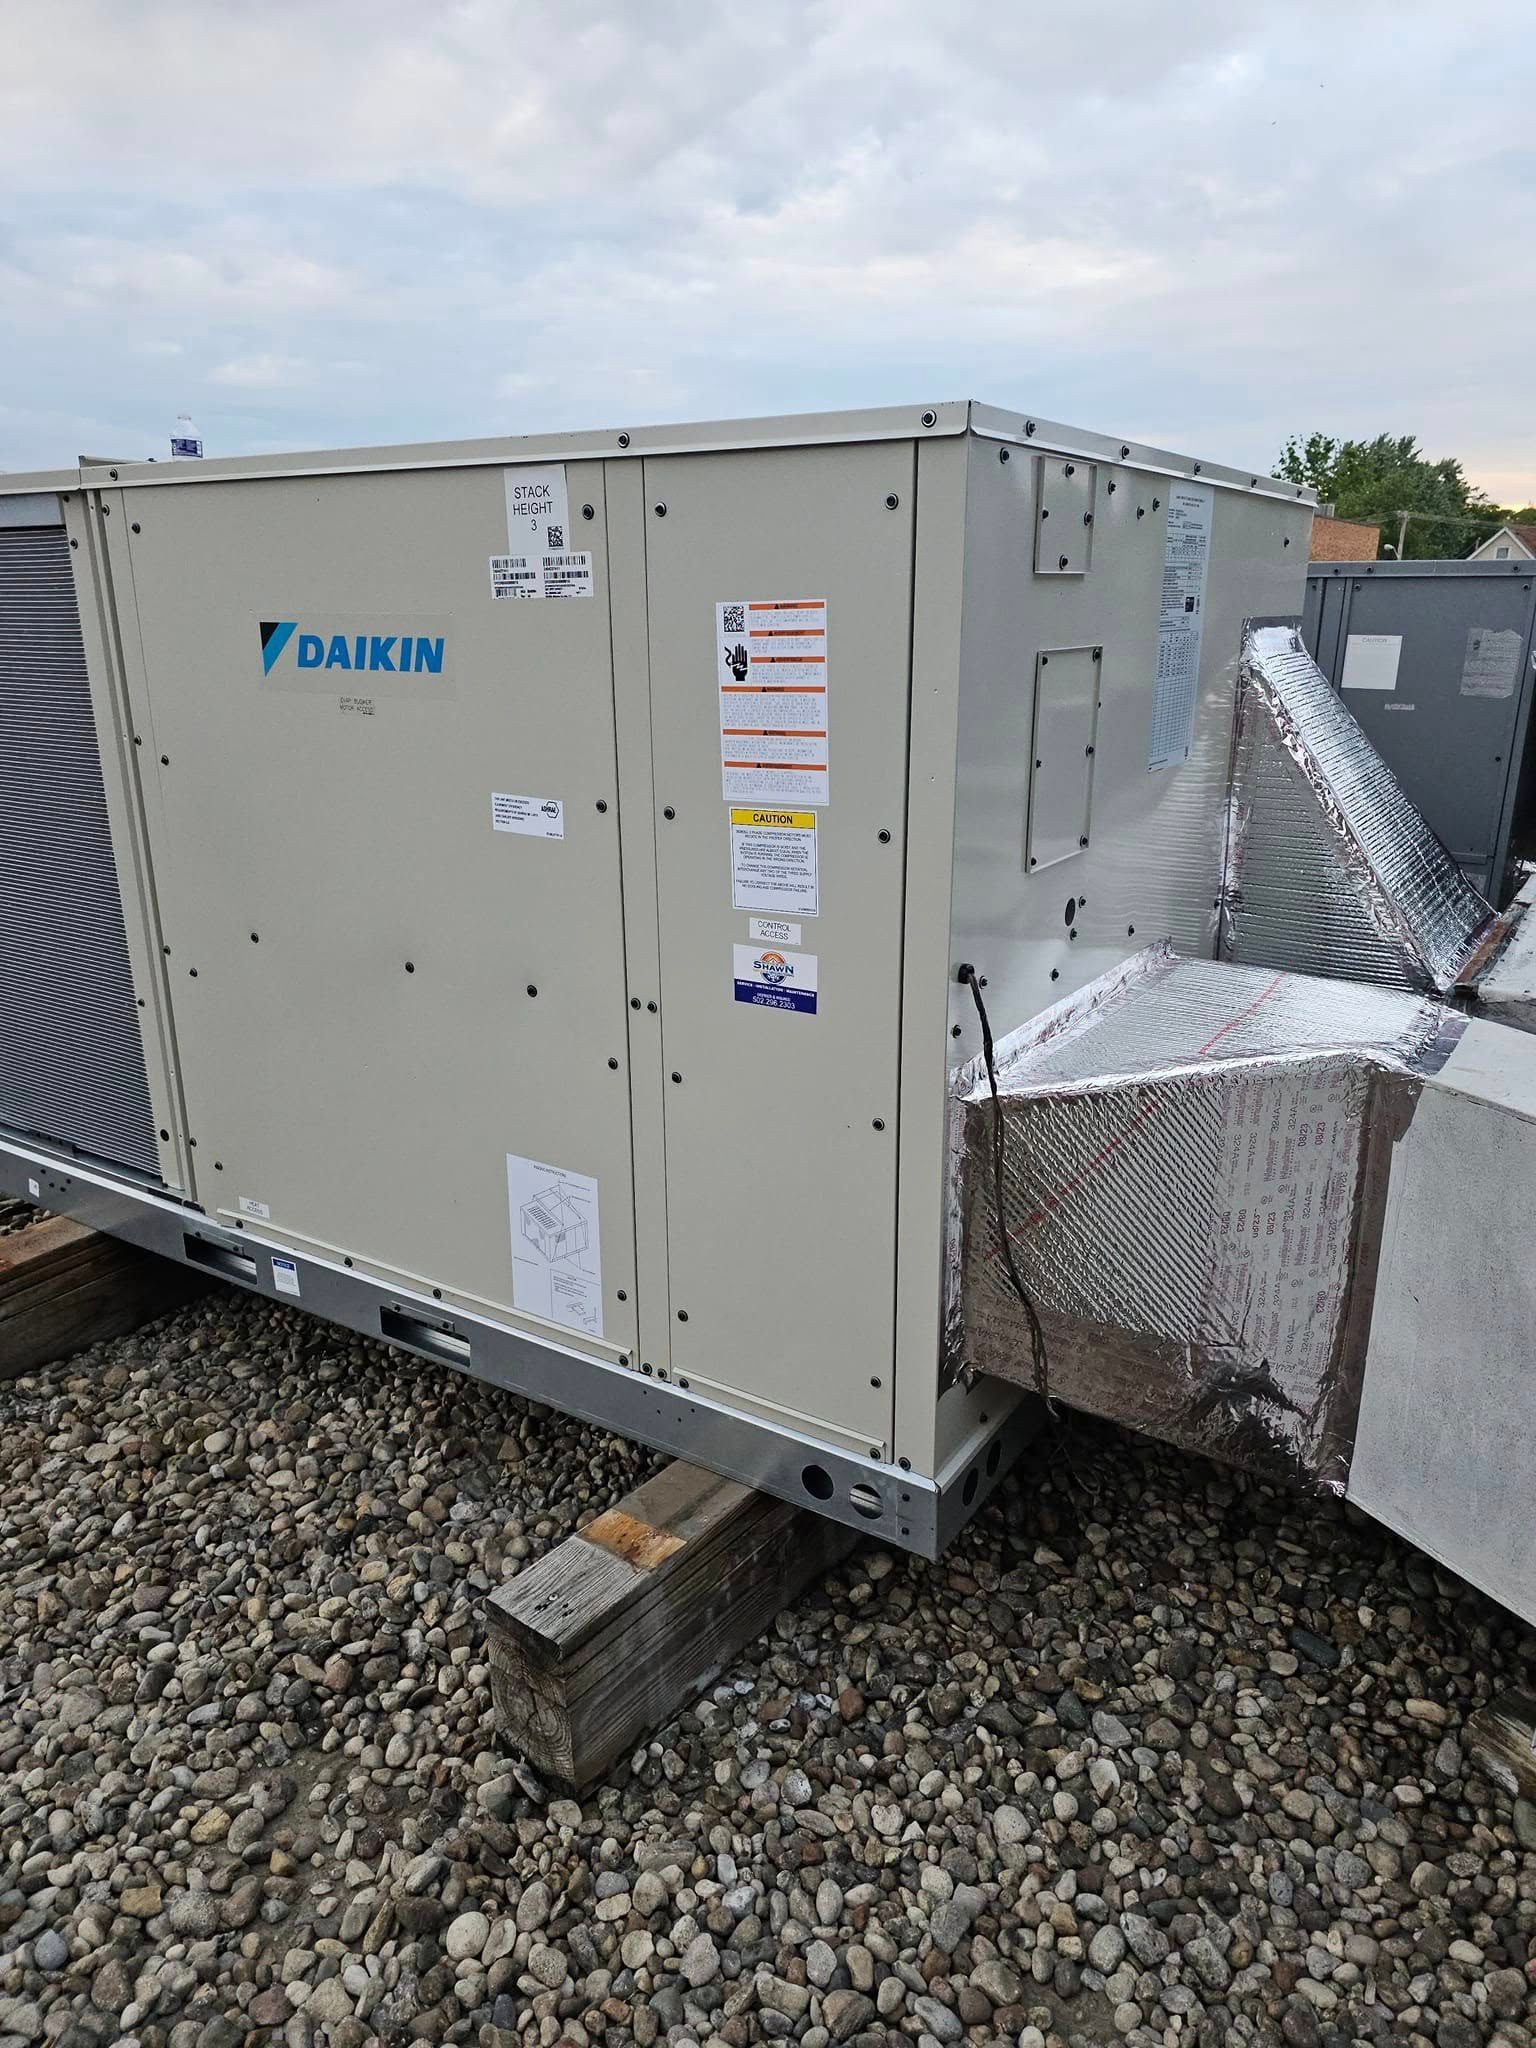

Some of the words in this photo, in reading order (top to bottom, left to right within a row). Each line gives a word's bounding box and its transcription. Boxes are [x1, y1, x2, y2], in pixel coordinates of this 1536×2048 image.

[514, 485, 551, 499] STACK
[513, 501, 553, 515] HEIGHT
[530, 519, 538, 531] 3
[297, 635, 445, 673] DAIKIN
[753, 813, 793, 824] CAUTION
[757, 920, 791, 932] CONTROL
[760, 930, 789, 940] ACCESS
[753, 960, 794, 974] SHAWN
[1271, 1107, 1281, 1132] 324A
[1288, 1106, 1298, 1130] 324A
[1247, 1132, 1257, 1158] 324A
[1298, 1123, 1308, 1147] 08/23
[1315, 1121, 1326, 1146] 08/23
[1231, 1134, 1241, 1159] 324A
[1303, 1196, 1312, 1220] 324A
[1221, 1211, 1231, 1234] 08/23
[1236, 1209, 1247, 1232] 08/23
[1266, 1211, 1276, 1235] 08/23
[1258, 1281, 1267, 1308] 324A
[1316, 1291, 1326, 1313] 08/23
[1285, 1331, 1296, 1355] 324A
[1301, 1330, 1312, 1353] 324A
